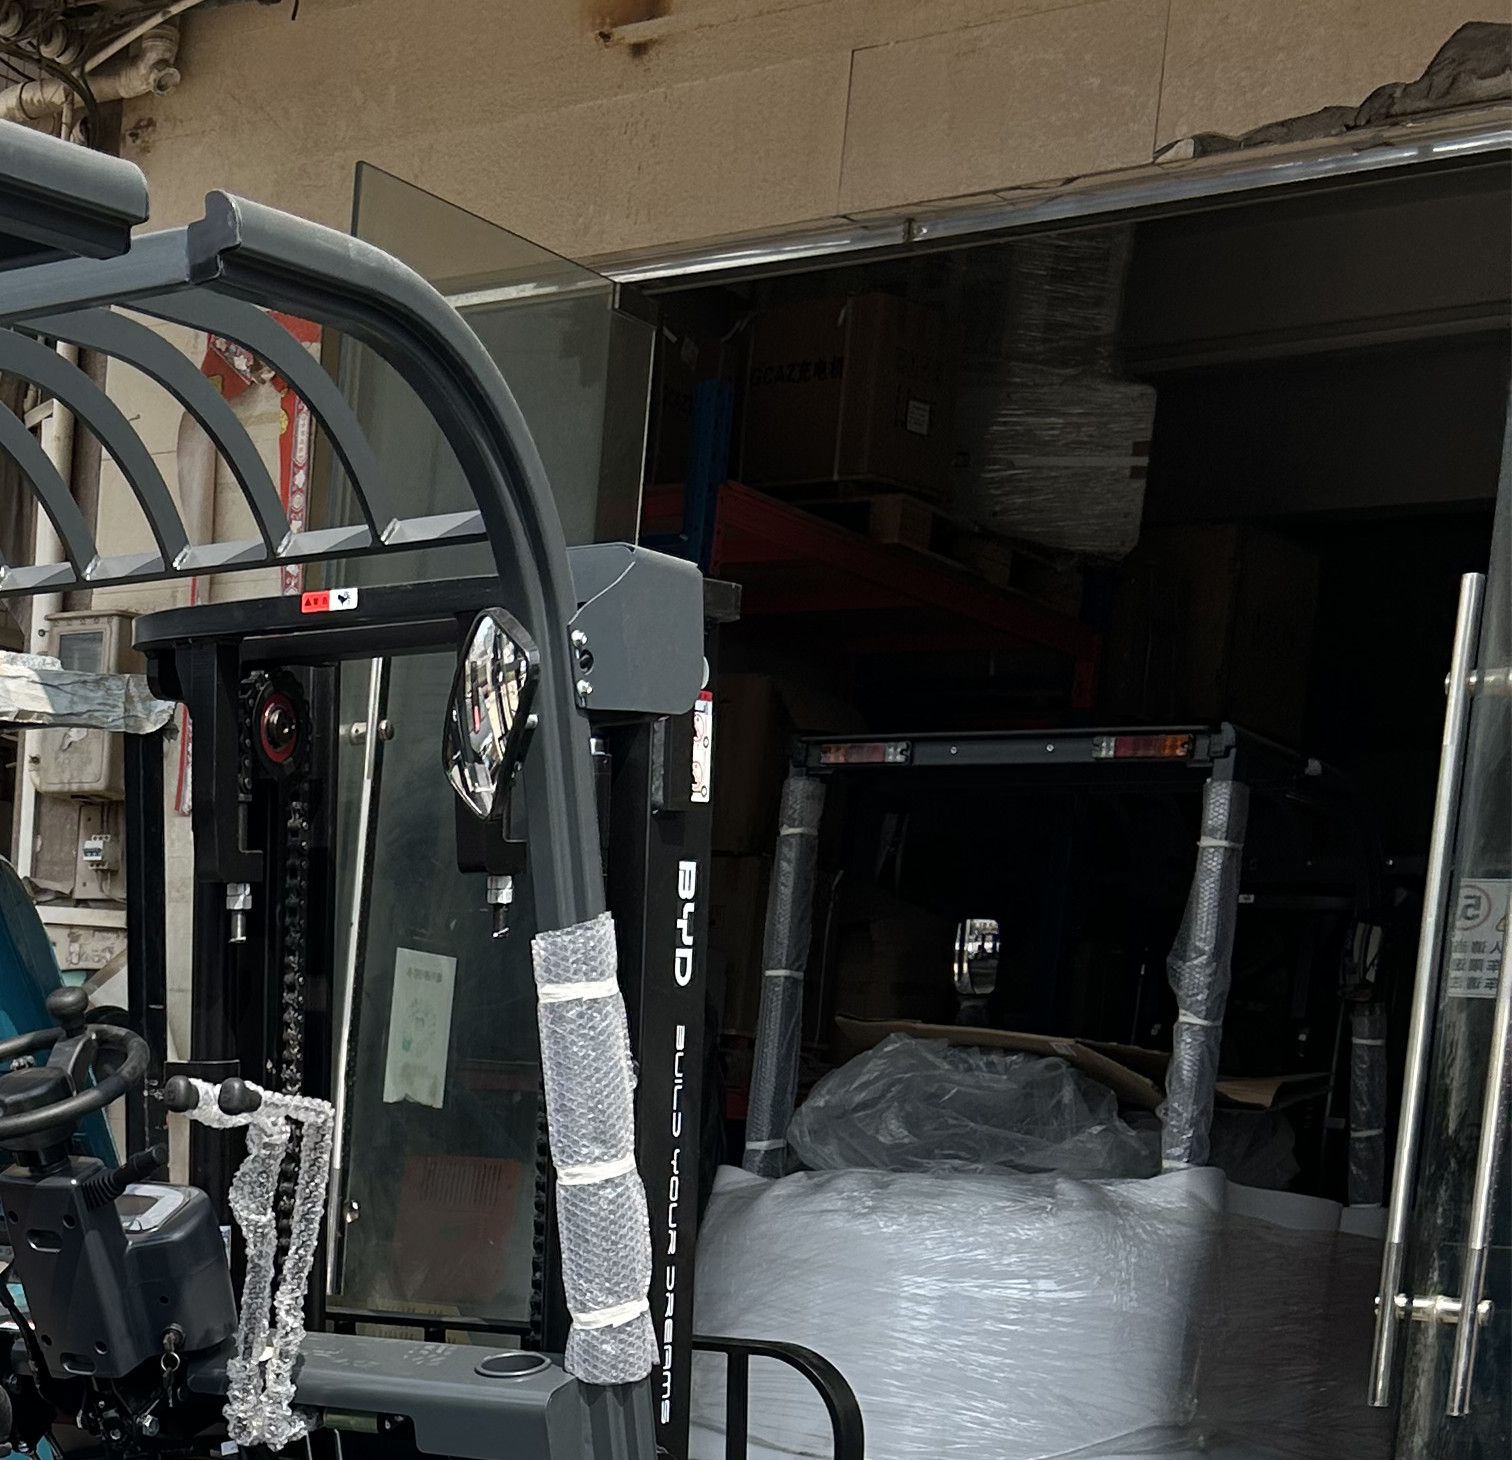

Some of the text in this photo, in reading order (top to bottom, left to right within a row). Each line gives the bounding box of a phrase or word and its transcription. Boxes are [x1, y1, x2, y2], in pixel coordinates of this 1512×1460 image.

[674, 860, 697, 987] BYD
[660, 1024, 686, 1425] BUILD YOUR DREAMS
